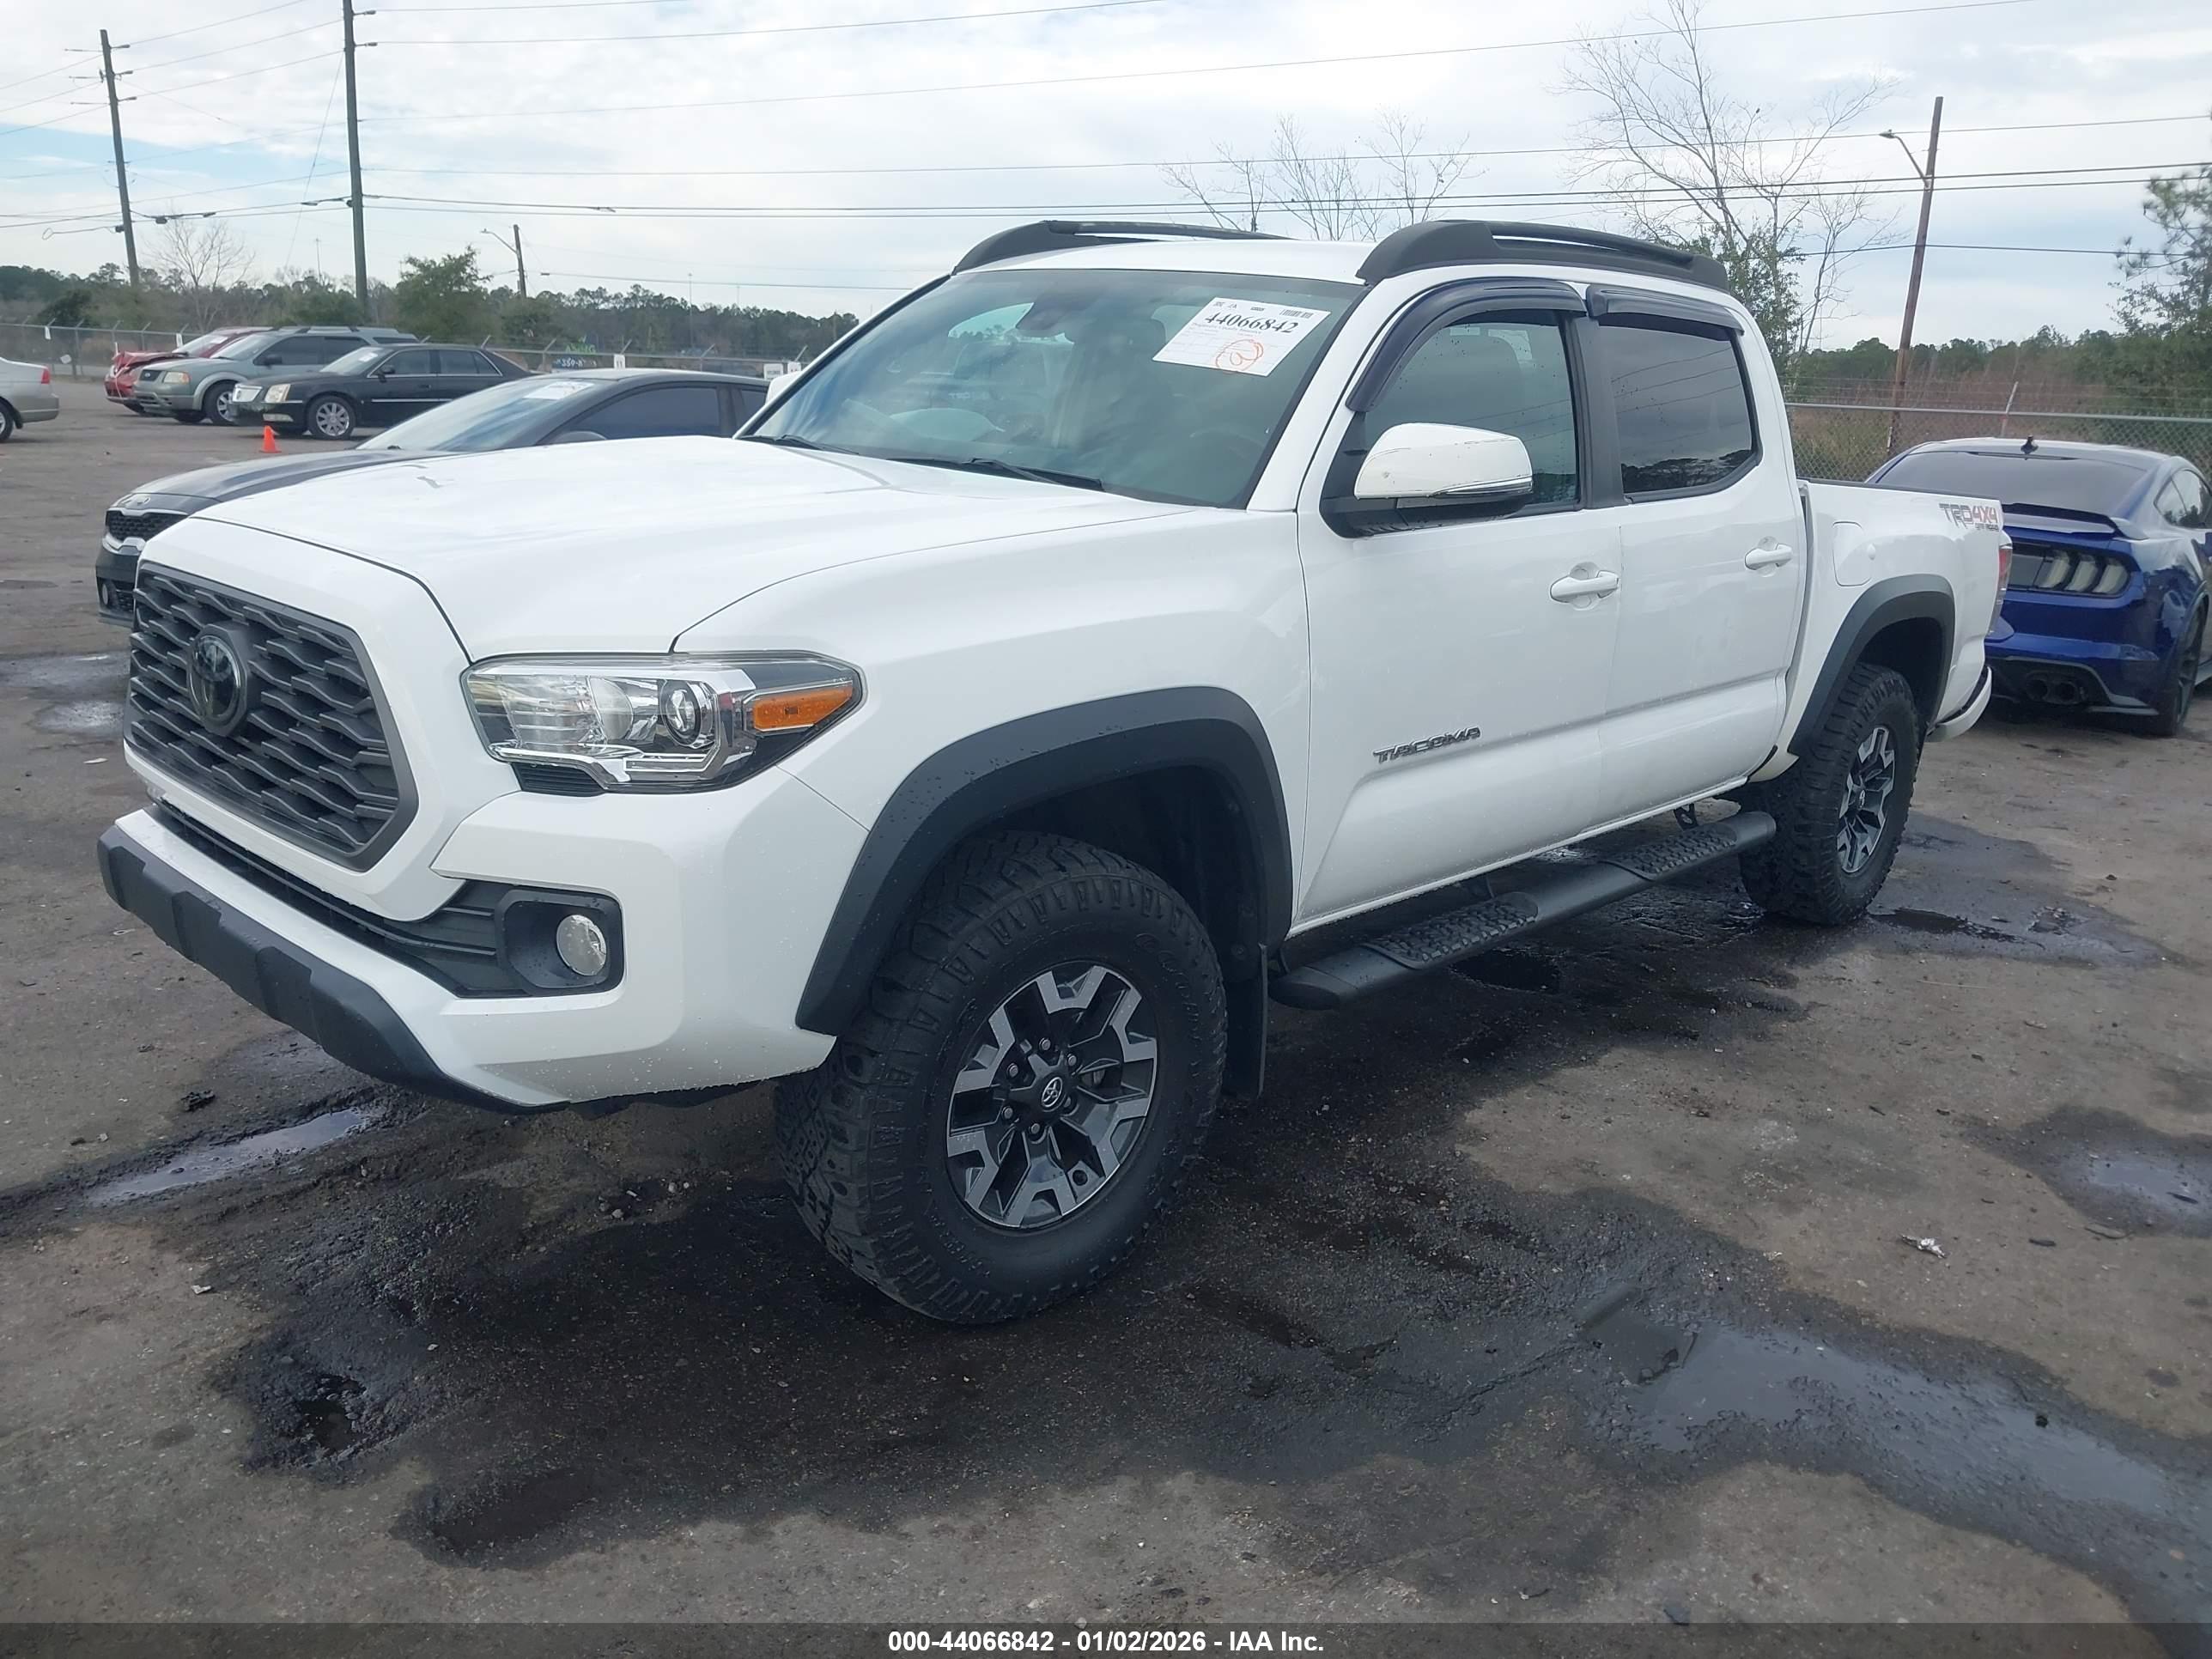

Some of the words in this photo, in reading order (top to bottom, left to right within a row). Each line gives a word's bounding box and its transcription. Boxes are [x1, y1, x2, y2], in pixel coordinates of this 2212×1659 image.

[1205, 312, 1299, 333] 44066842
[1938, 502, 1973, 529] TRD
[1373, 726, 1481, 763] TACOMA
